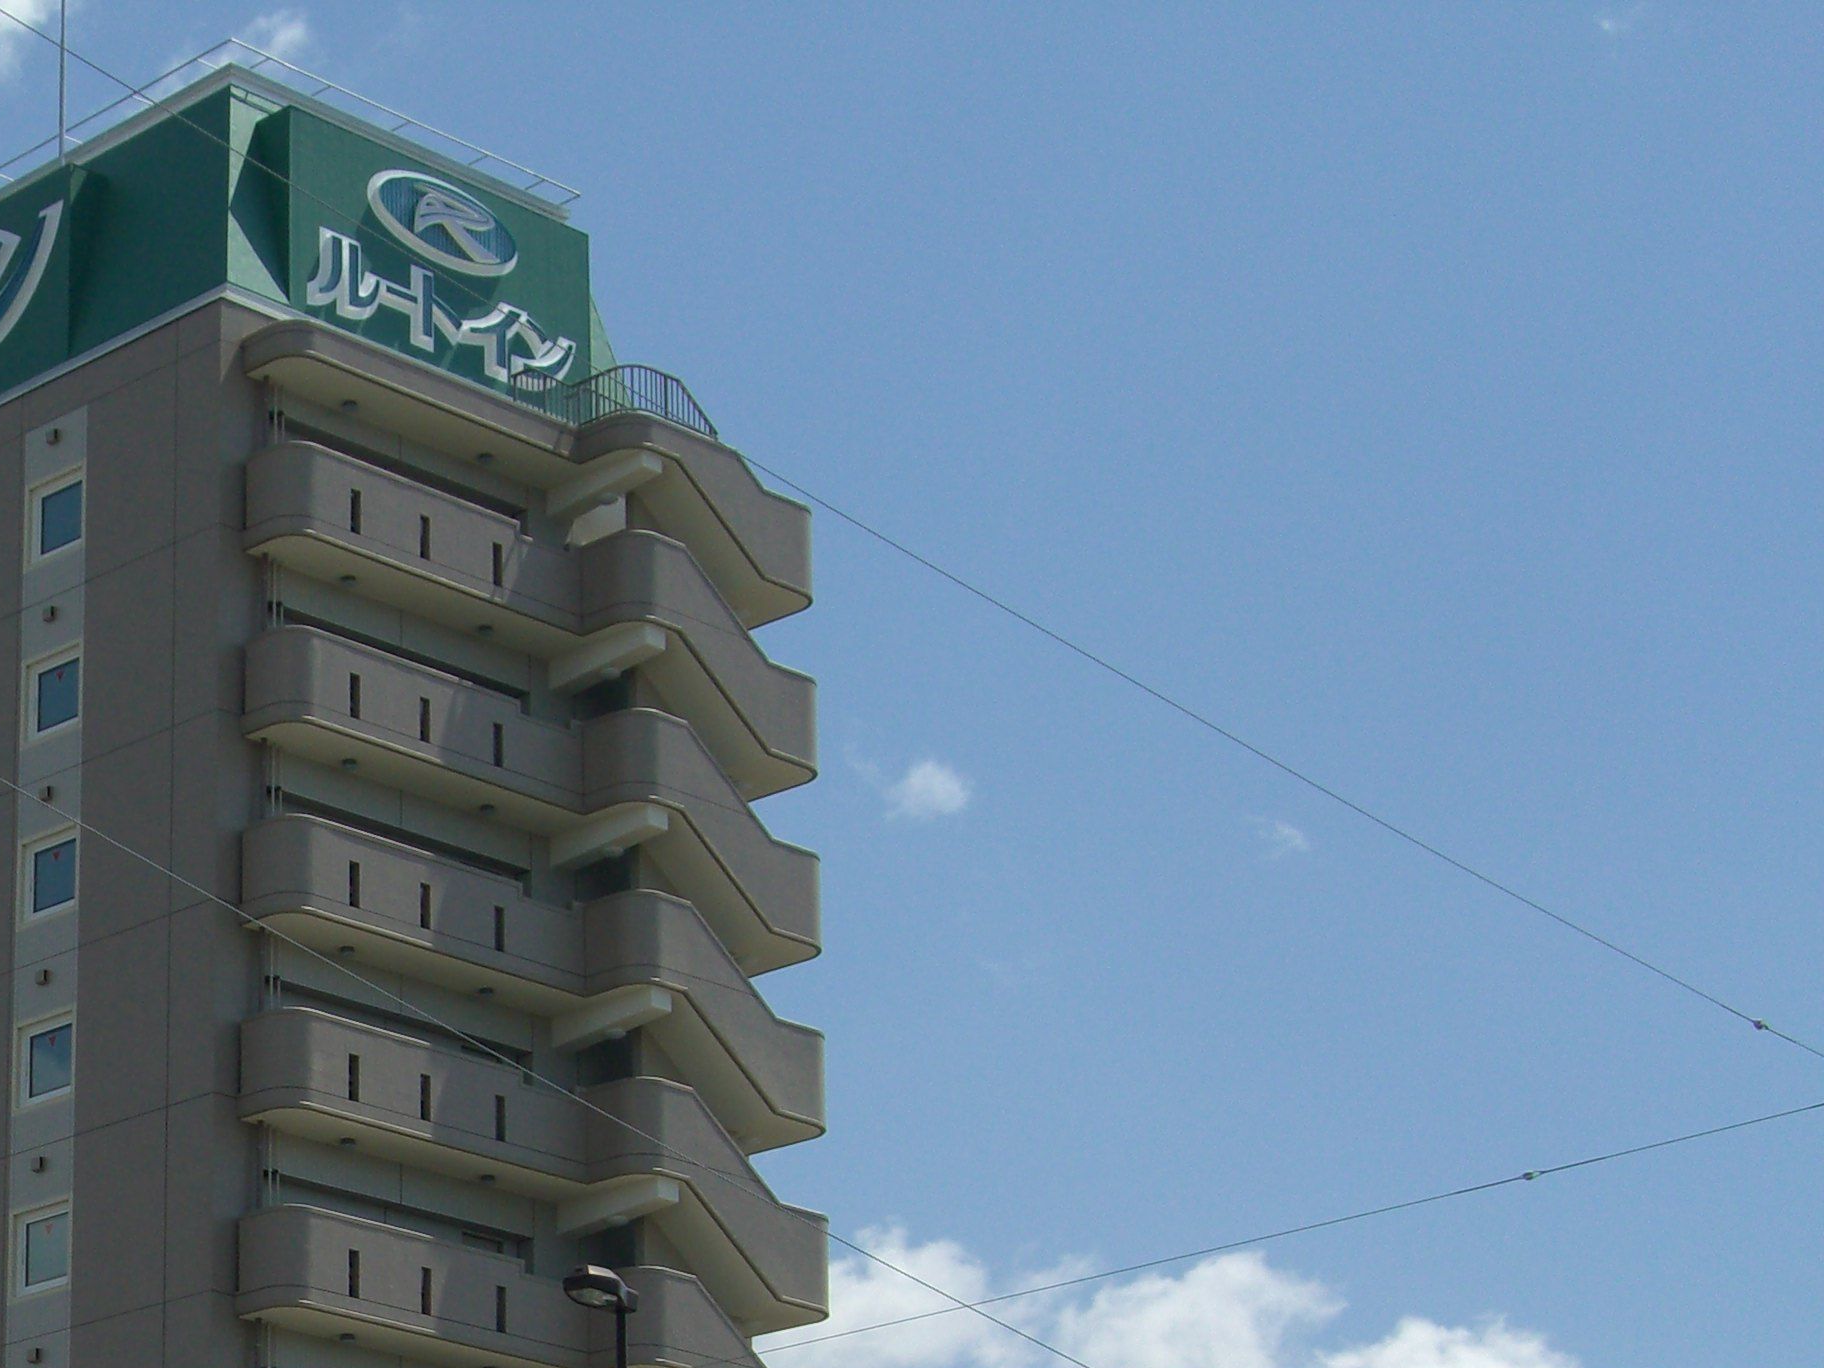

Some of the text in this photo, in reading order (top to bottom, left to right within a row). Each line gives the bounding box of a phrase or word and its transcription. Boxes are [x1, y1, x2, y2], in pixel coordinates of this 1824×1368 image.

[307, 226, 576, 391] ルートイン
